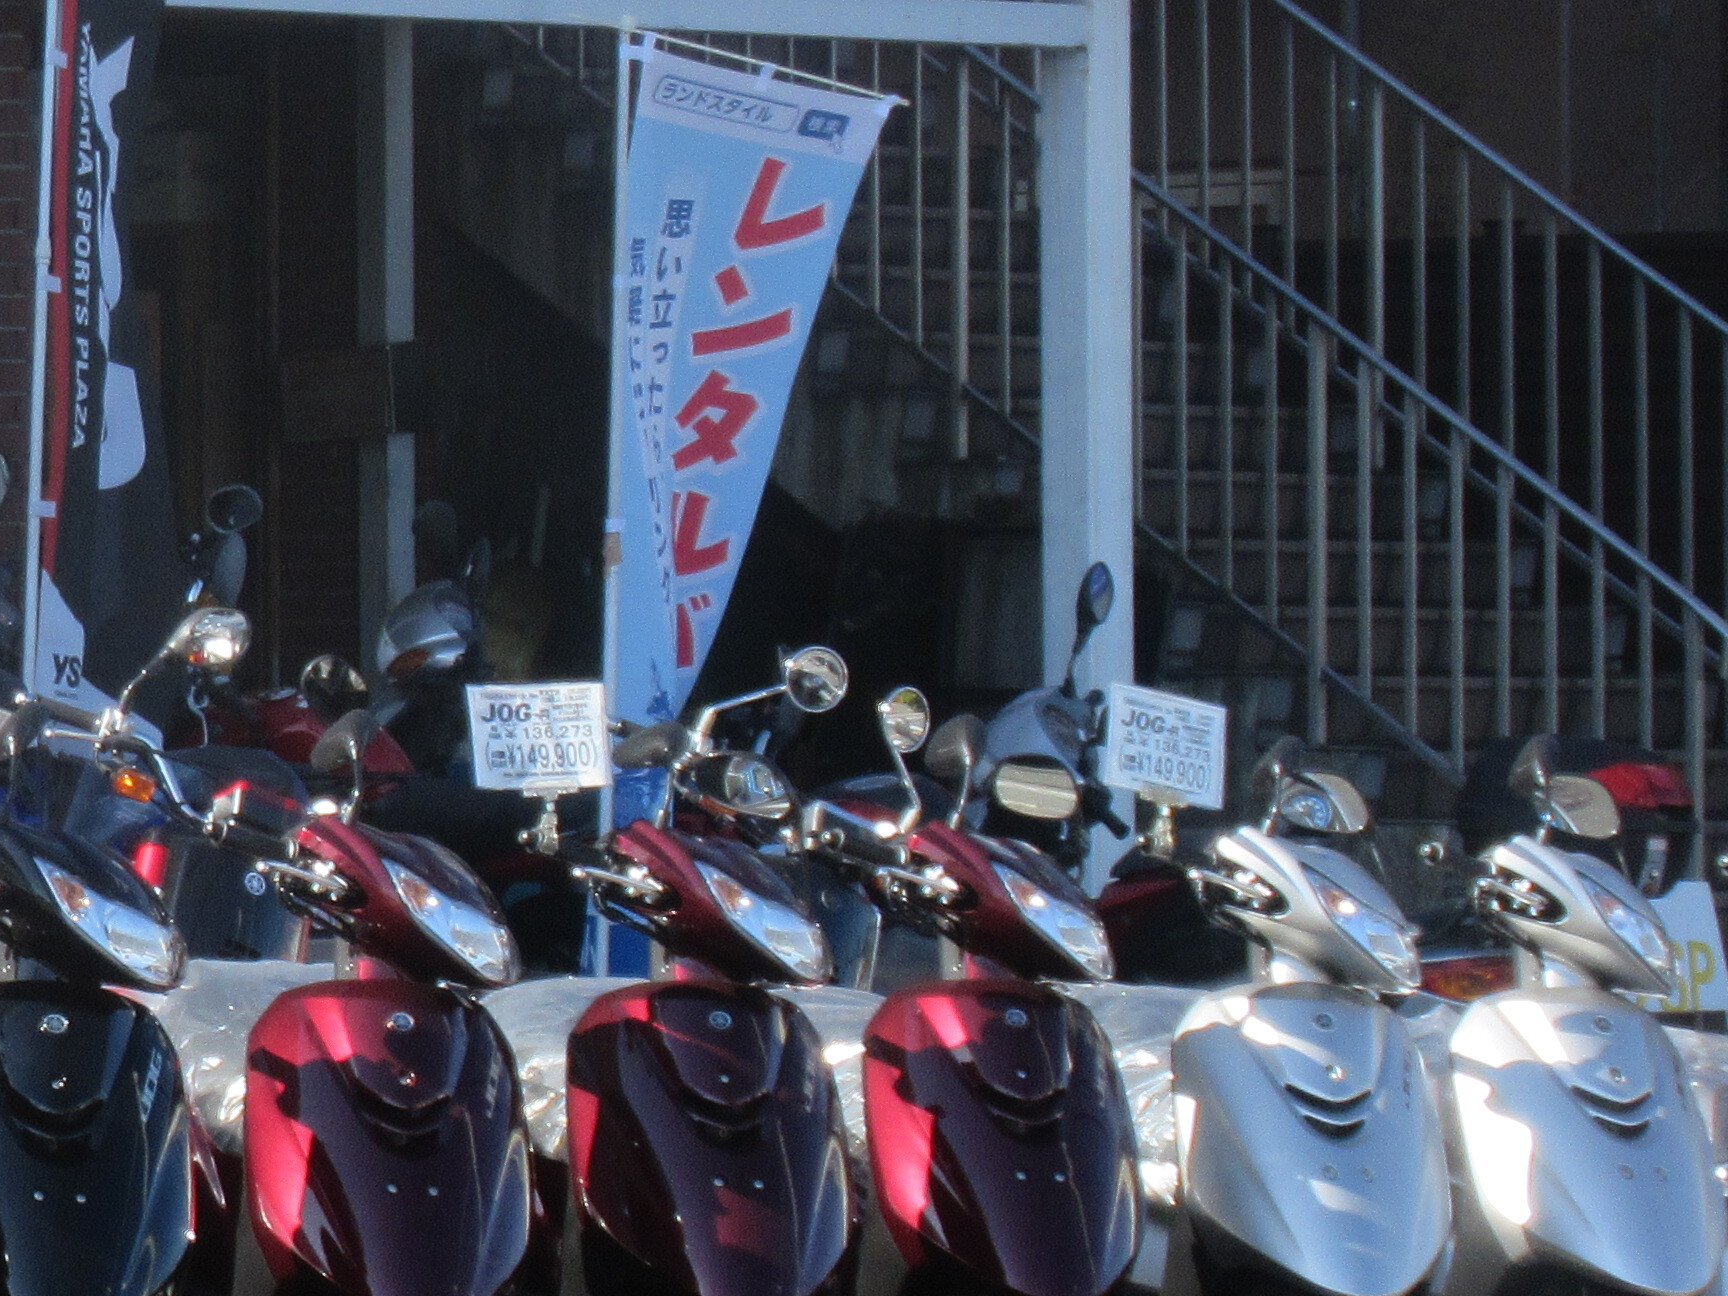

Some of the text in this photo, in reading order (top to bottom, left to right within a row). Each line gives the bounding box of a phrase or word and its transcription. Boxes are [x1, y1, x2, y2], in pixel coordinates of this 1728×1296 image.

[73, 185, 93, 327] SPORTS
[71, 336, 91, 450] PLAZA
[52, 652, 81, 688] YS
[481, 703, 532, 723] JOG
[1121, 709, 1166, 733] JOG
[1638, 939, 1716, 1012] SP
